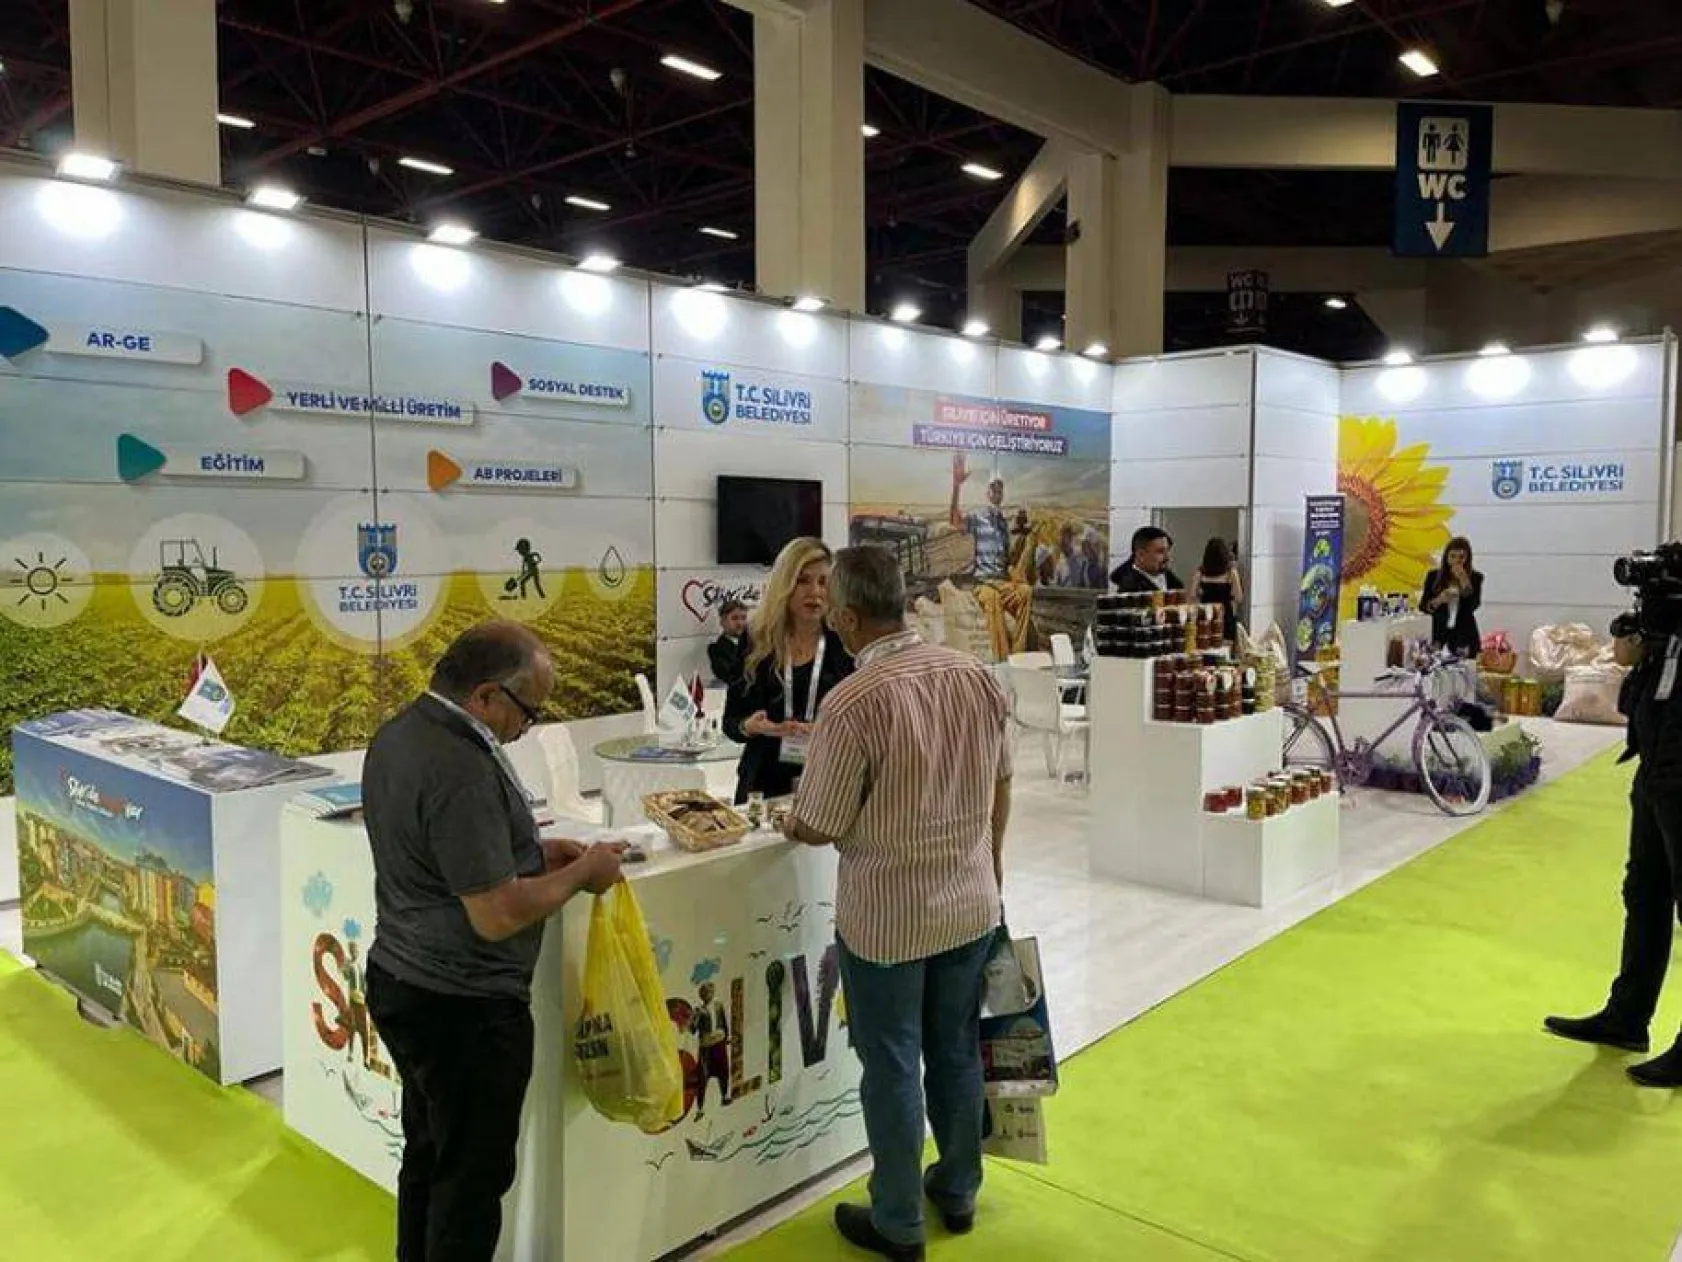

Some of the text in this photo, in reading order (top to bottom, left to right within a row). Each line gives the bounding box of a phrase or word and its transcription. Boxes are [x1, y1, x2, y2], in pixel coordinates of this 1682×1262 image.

[1417, 172, 1467, 199] WC
[87, 332, 150, 351] AR-GE
[528, 378, 624, 399] SOSYAL DESTEK
[287, 391, 335, 409] YERLİ
[338, 396, 360, 411] VE
[407, 398, 461, 419] ÜRETİM
[201, 452, 265, 472] EĞİTİM
[474, 468, 562, 483] AB PROJELERİ
